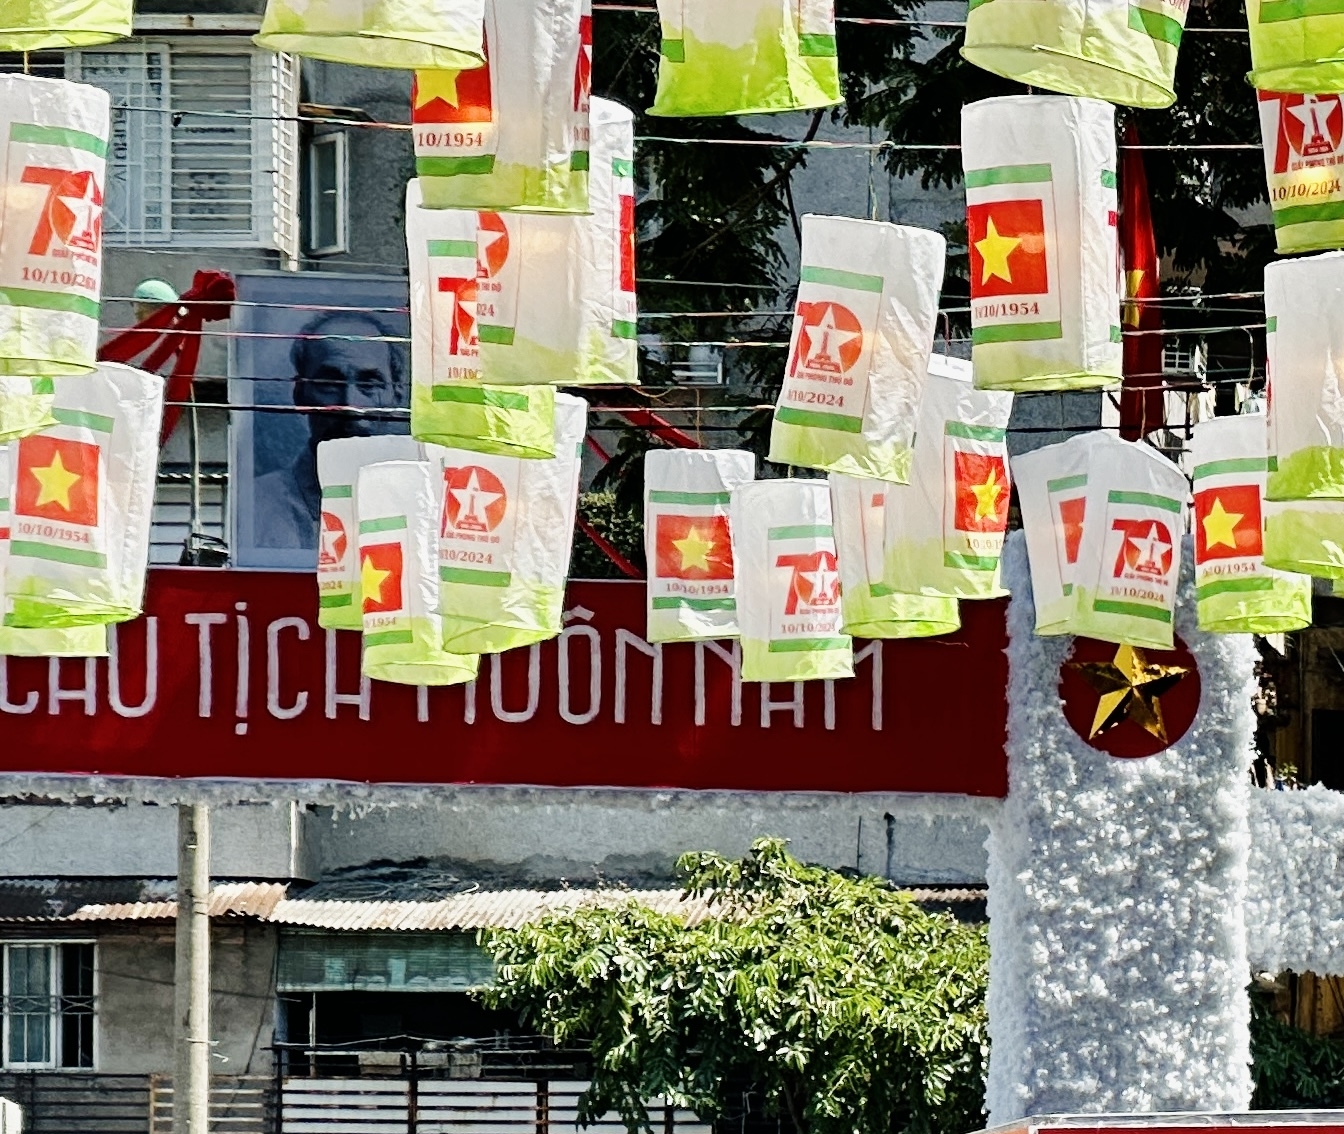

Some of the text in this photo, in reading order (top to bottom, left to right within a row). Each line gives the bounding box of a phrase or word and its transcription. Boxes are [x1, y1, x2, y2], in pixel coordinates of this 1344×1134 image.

[1271, 180, 1341, 201] 10/10/2024
[18, 522, 90, 544] 10/10/1954
[185, 601, 371, 735] TỊCH
